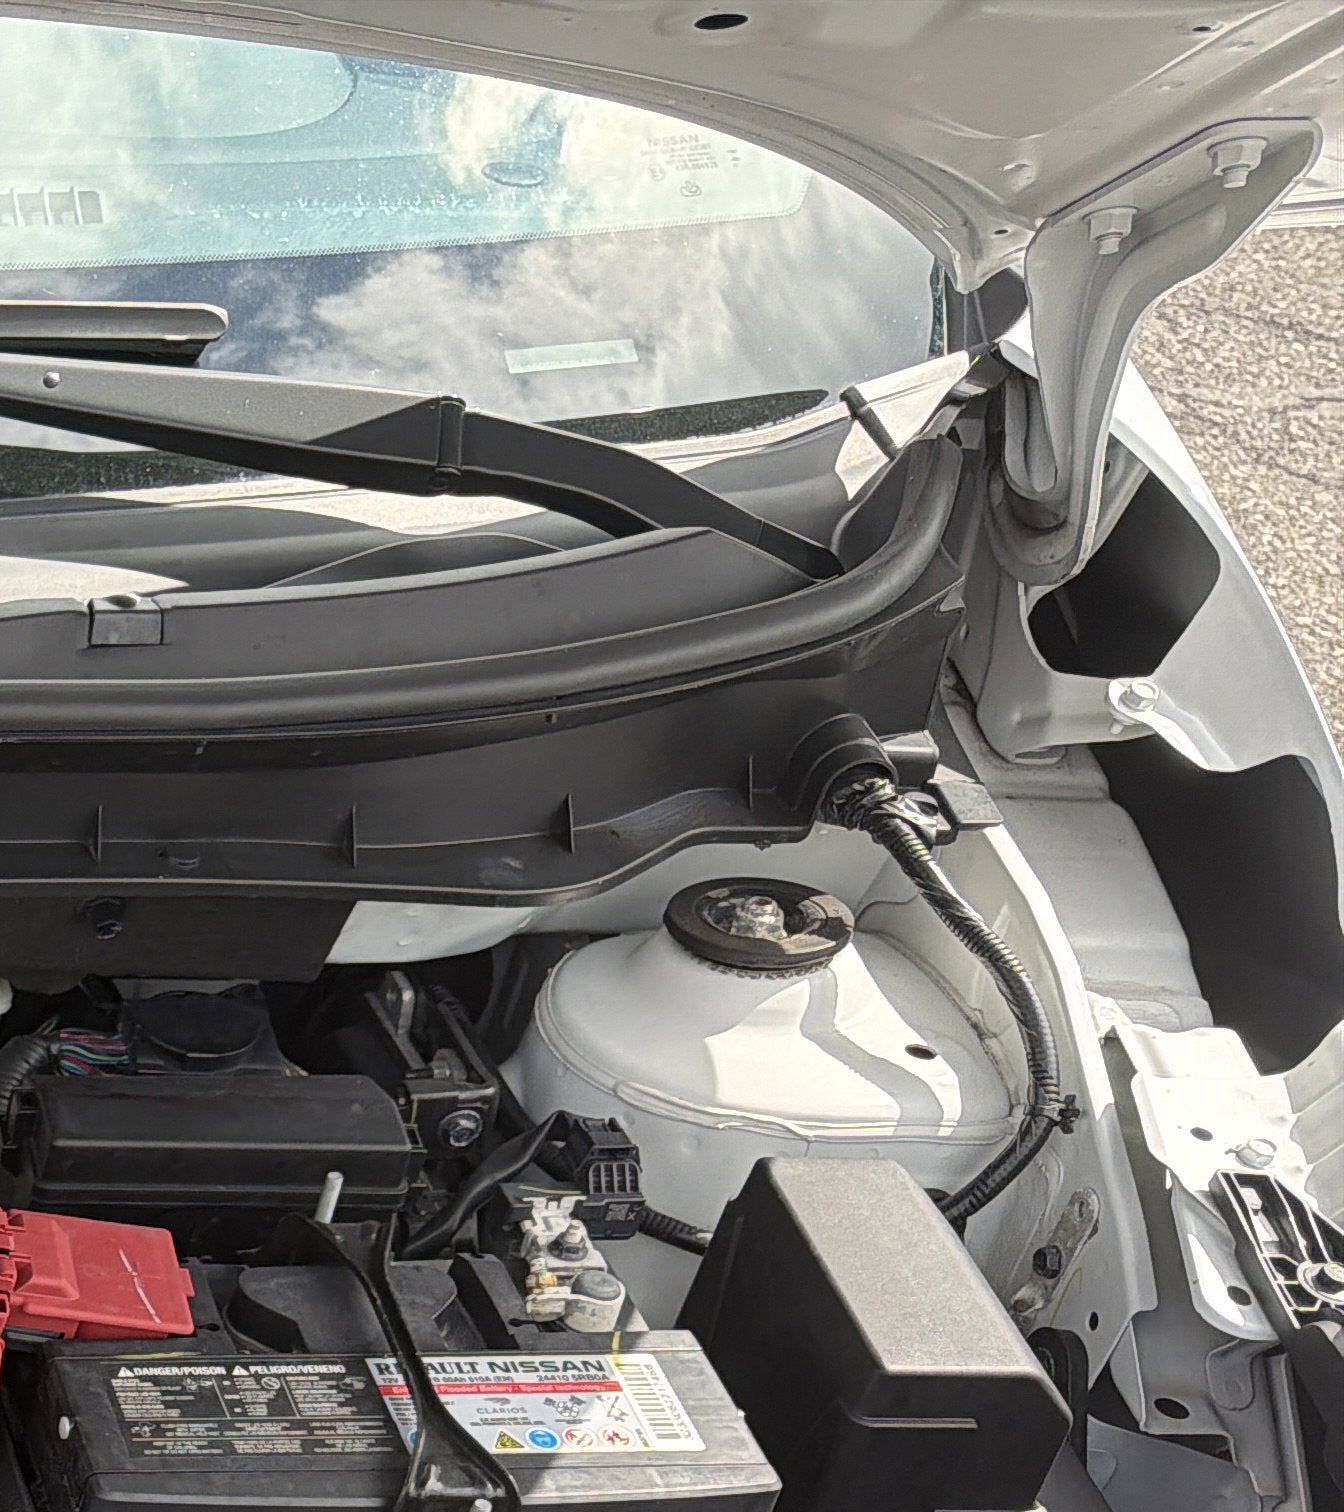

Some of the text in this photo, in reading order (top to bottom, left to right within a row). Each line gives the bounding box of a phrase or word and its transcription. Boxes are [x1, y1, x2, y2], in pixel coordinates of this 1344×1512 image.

[373, 1360, 606, 1376] RAULT NISSAN
[476, 1407, 528, 1415] CLARIOS
